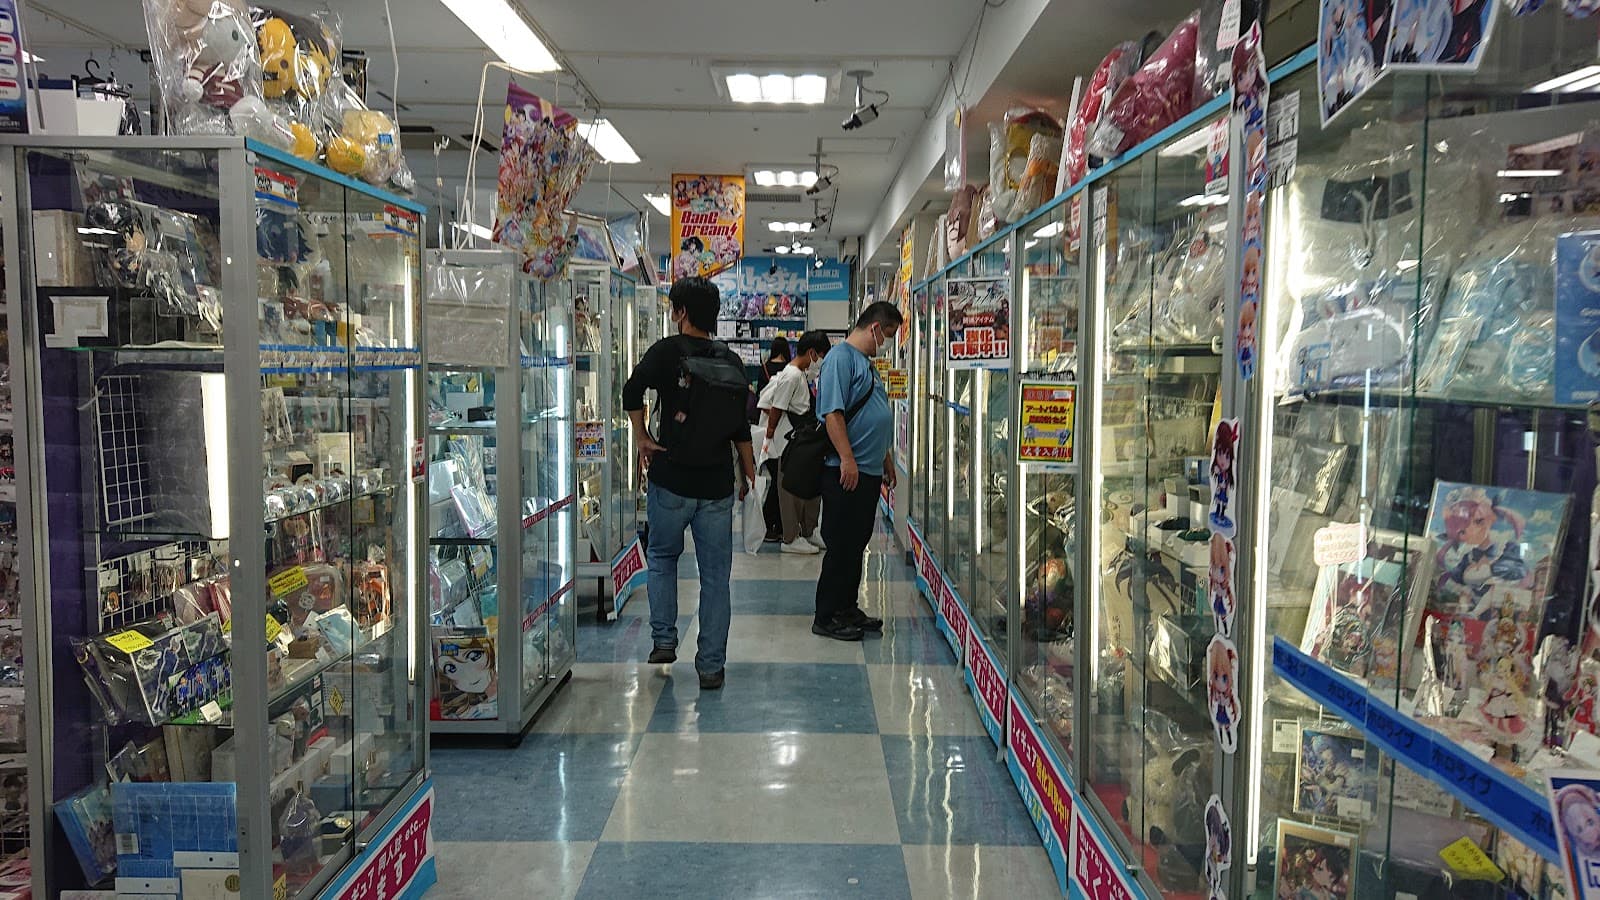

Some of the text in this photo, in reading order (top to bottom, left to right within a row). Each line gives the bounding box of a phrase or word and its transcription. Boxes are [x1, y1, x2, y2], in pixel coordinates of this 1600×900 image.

[681, 211, 718, 224] BanG
[681, 222, 737, 241] Dream!
[1432, 748, 1492, 795] ホロライブ
